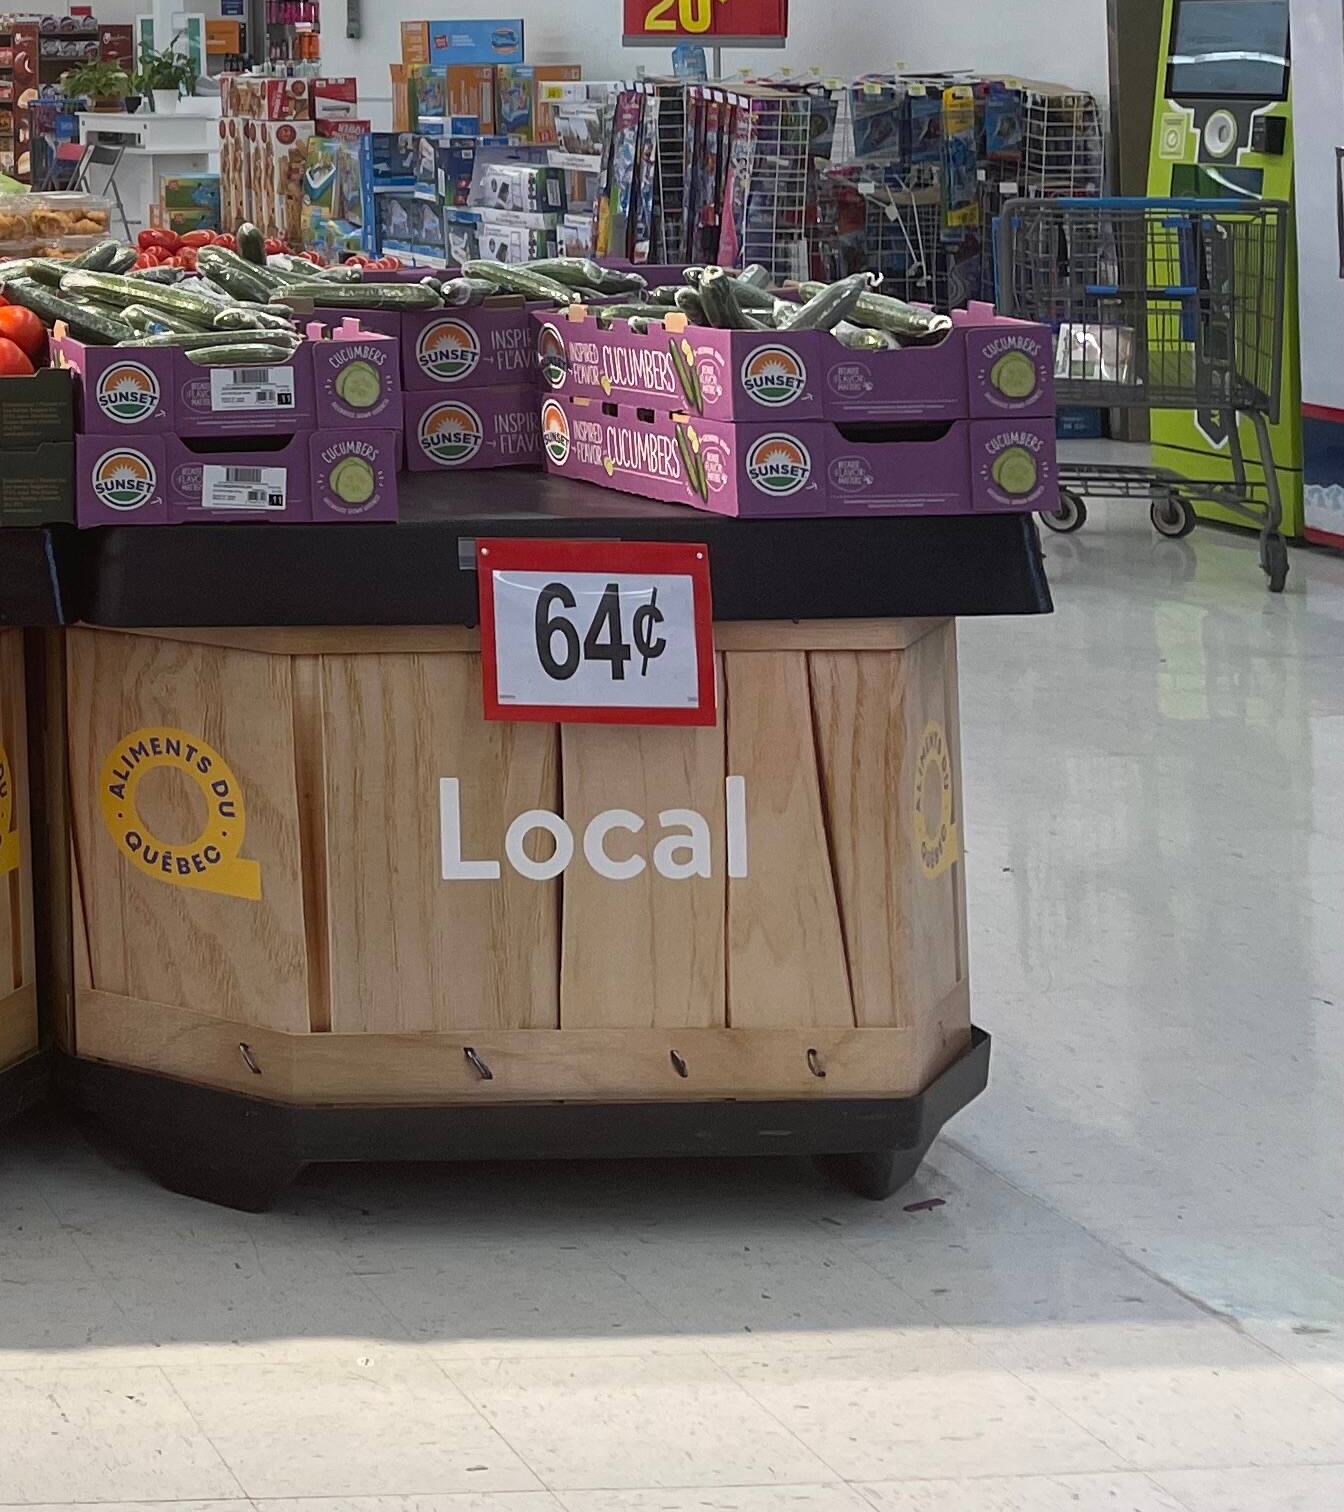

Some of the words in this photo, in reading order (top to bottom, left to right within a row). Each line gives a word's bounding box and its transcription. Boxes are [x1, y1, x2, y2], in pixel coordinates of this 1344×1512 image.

[328, 345, 388, 369] CUCUMBERS
[419, 349, 480, 366] SUNSET
[981, 336, 1041, 359] CUCUMBERS
[602, 344, 676, 394] CUCUMBERS
[743, 375, 805, 390] SUNSET
[99, 391, 158, 408] SUNSET
[321, 440, 380, 464] CUCUMBERS
[421, 433, 483, 449] SUNSET
[606, 425, 681, 479] CUCUMBERS
[984, 431, 1045, 455] CUCUMBERS
[749, 465, 809, 480] SUNSET
[95, 477, 156, 494] SUNSET
[535, 582, 667, 681] 64¢
[109, 737, 212, 800] ALIMENTS
[211, 779, 236, 818] DU
[439, 774, 748, 881] Local
[125, 831, 221, 875] QUÉBEC
